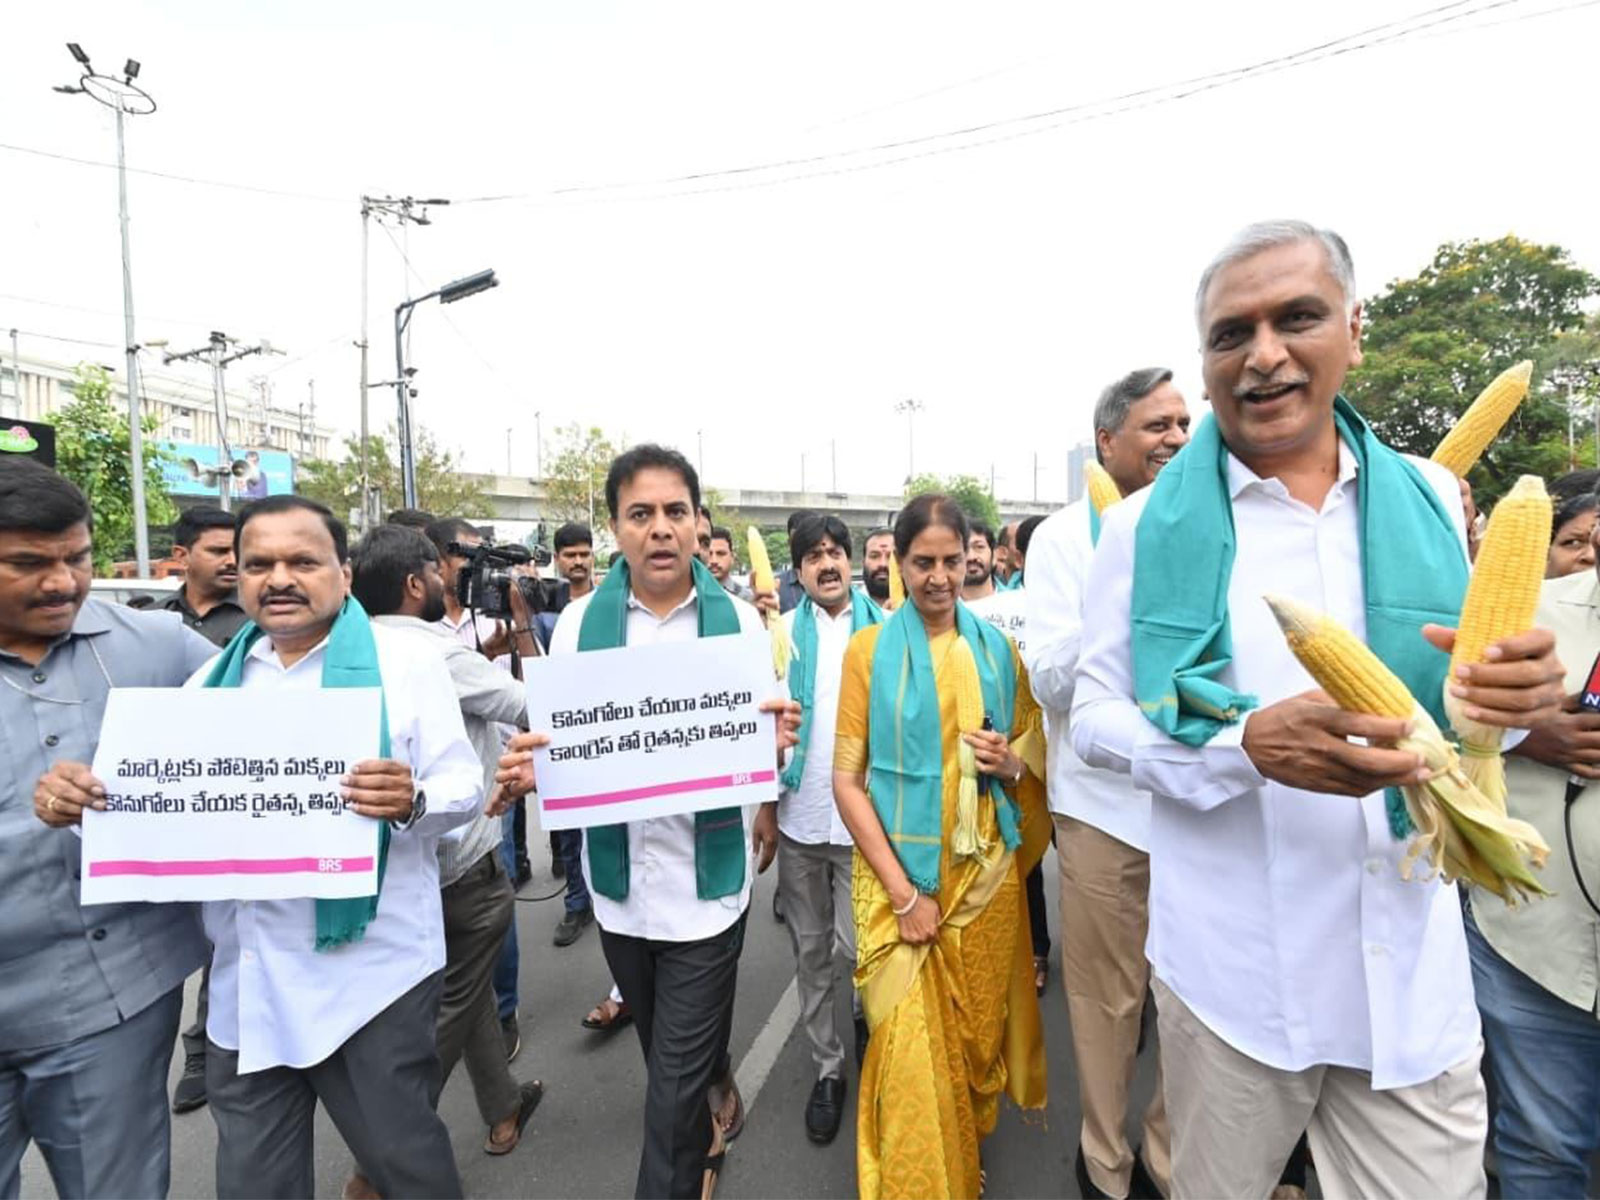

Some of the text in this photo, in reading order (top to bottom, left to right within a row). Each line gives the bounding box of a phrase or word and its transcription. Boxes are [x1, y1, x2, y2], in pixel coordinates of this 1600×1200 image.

[551, 690, 752, 729] కొనుగోలు చేయరా మక్కలు
[618, 730, 640, 752] తో
[643, 725, 705, 754] రైతన్నకు
[709, 721, 757, 742] తిప్పలు
[117, 758, 202, 784] మార్కెట్లకు
[284, 757, 345, 781] మక్కలు
[732, 773, 752, 784] BRS
[105, 791, 185, 813] కొనుగోలు
[189, 790, 247, 813] చేయక
[251, 792, 307, 818] రైతన్న
[318, 858, 343, 872] BRS
